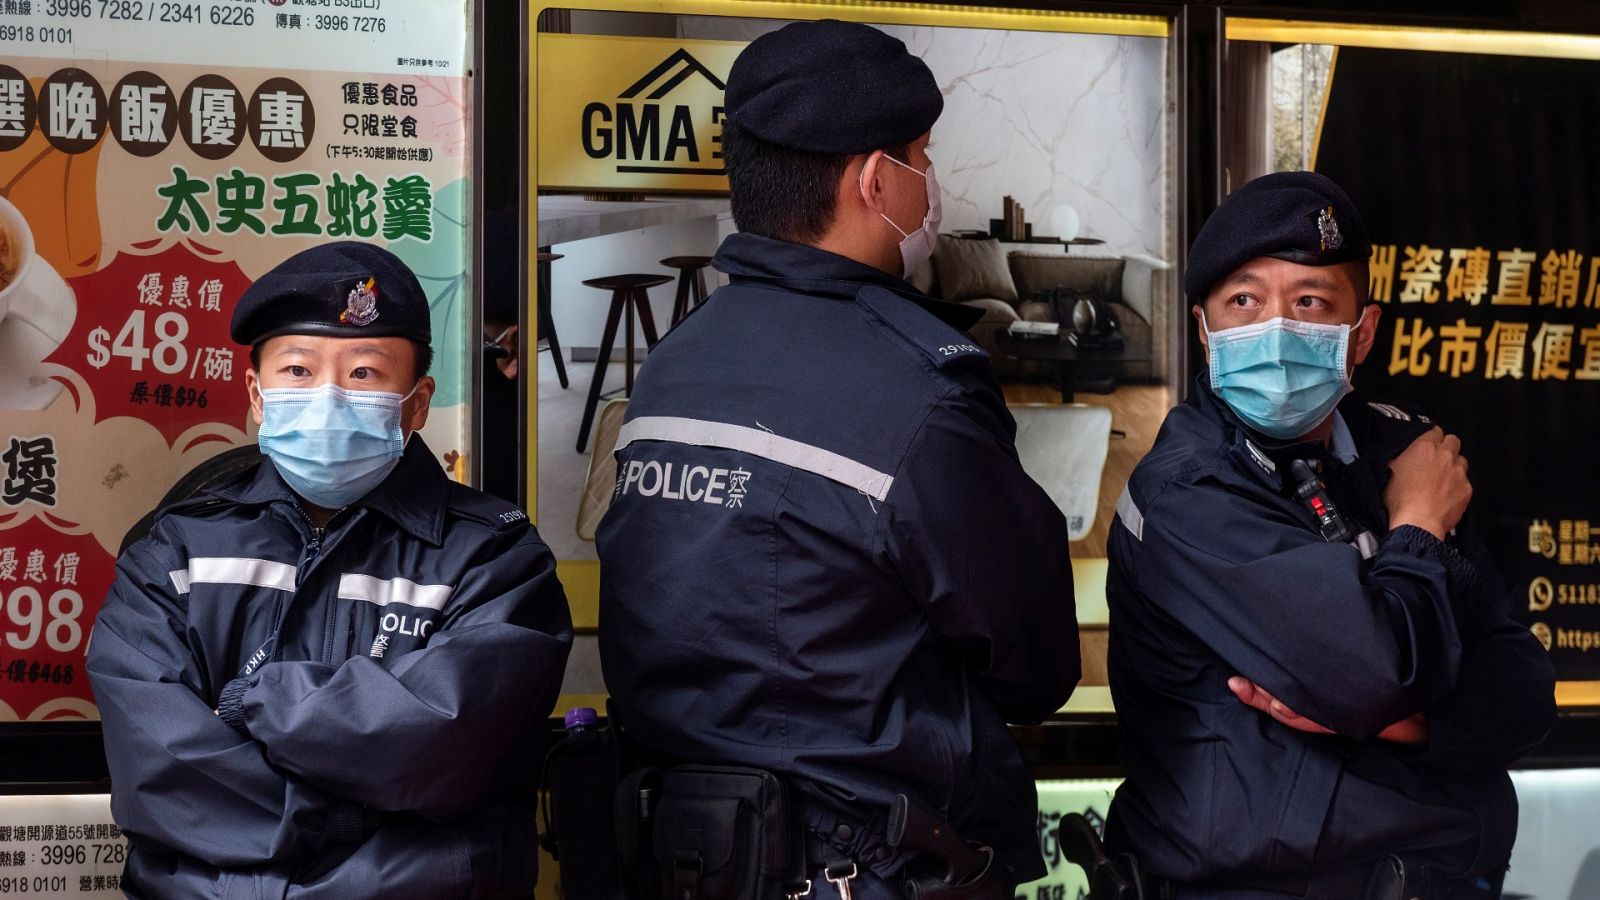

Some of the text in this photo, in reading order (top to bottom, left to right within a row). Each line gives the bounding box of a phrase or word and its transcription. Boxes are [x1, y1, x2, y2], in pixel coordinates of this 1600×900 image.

[46, 0, 91, 18] 3996
[100, 0, 144, 21] 7282
[160, 3, 203, 24] 2341
[210, 5, 254, 26] 6226
[315, 15, 349, 31] 3996
[353, 17, 386, 33] 7276
[0, 25, 73, 43] 6918 0101
[341, 82, 418, 107] 優惠食品
[343, 113, 418, 138] 只限堂食
[581, 103, 699, 161] GMA
[157, 167, 432, 241] 太史五蛇羹
[137, 272, 224, 312] 優惠價
[1388, 318, 1600, 381] 比市價便宜
[2, 437, 56, 506] 煲
[380, 612, 434, 639] OLIC
[41, 845, 86, 865] 3996
[0, 874, 123, 893] 918 0101 營業時
